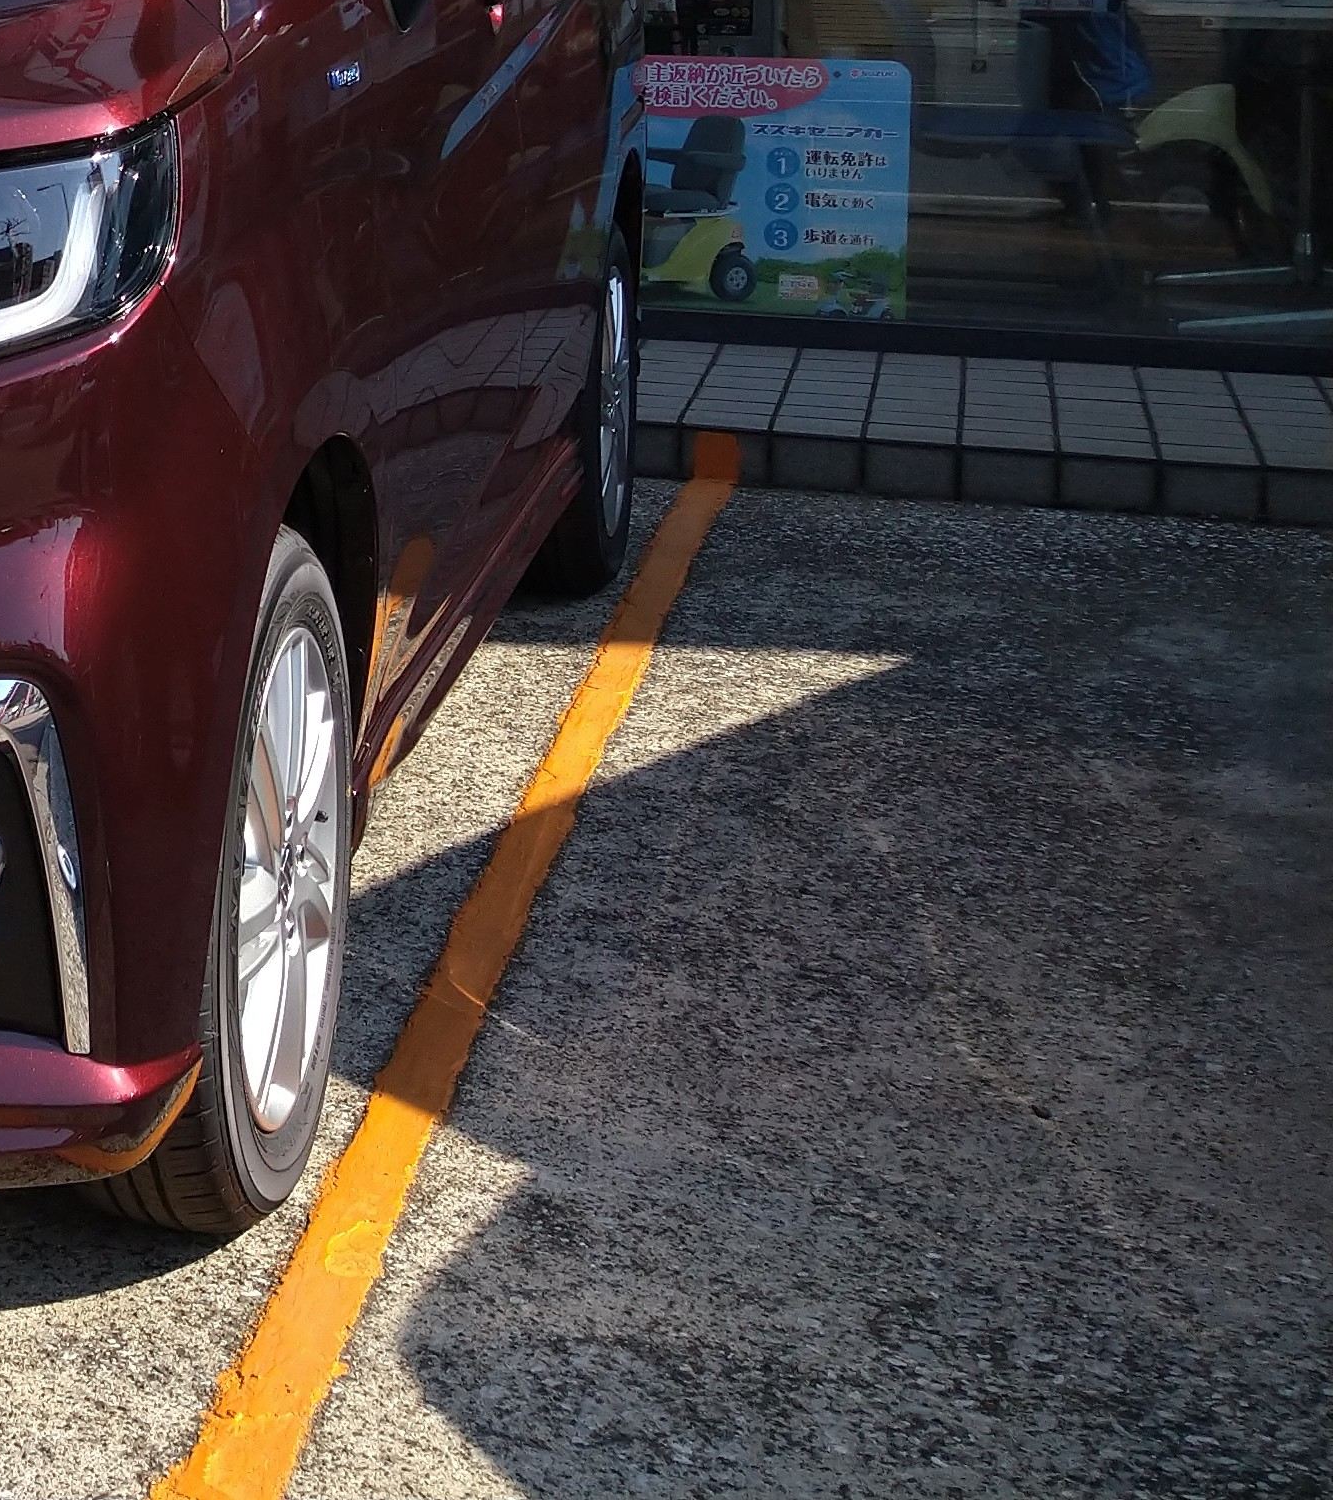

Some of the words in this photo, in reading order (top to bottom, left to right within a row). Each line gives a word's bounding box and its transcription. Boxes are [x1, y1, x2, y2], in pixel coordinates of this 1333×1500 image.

[751, 122, 900, 139] スズキセニアカー
[805, 149, 888, 169] 運転免許は
[805, 168, 864, 180] いりません
[804, 192, 876, 210] 電気で動く
[803, 228, 875, 247] 歩道を通行
